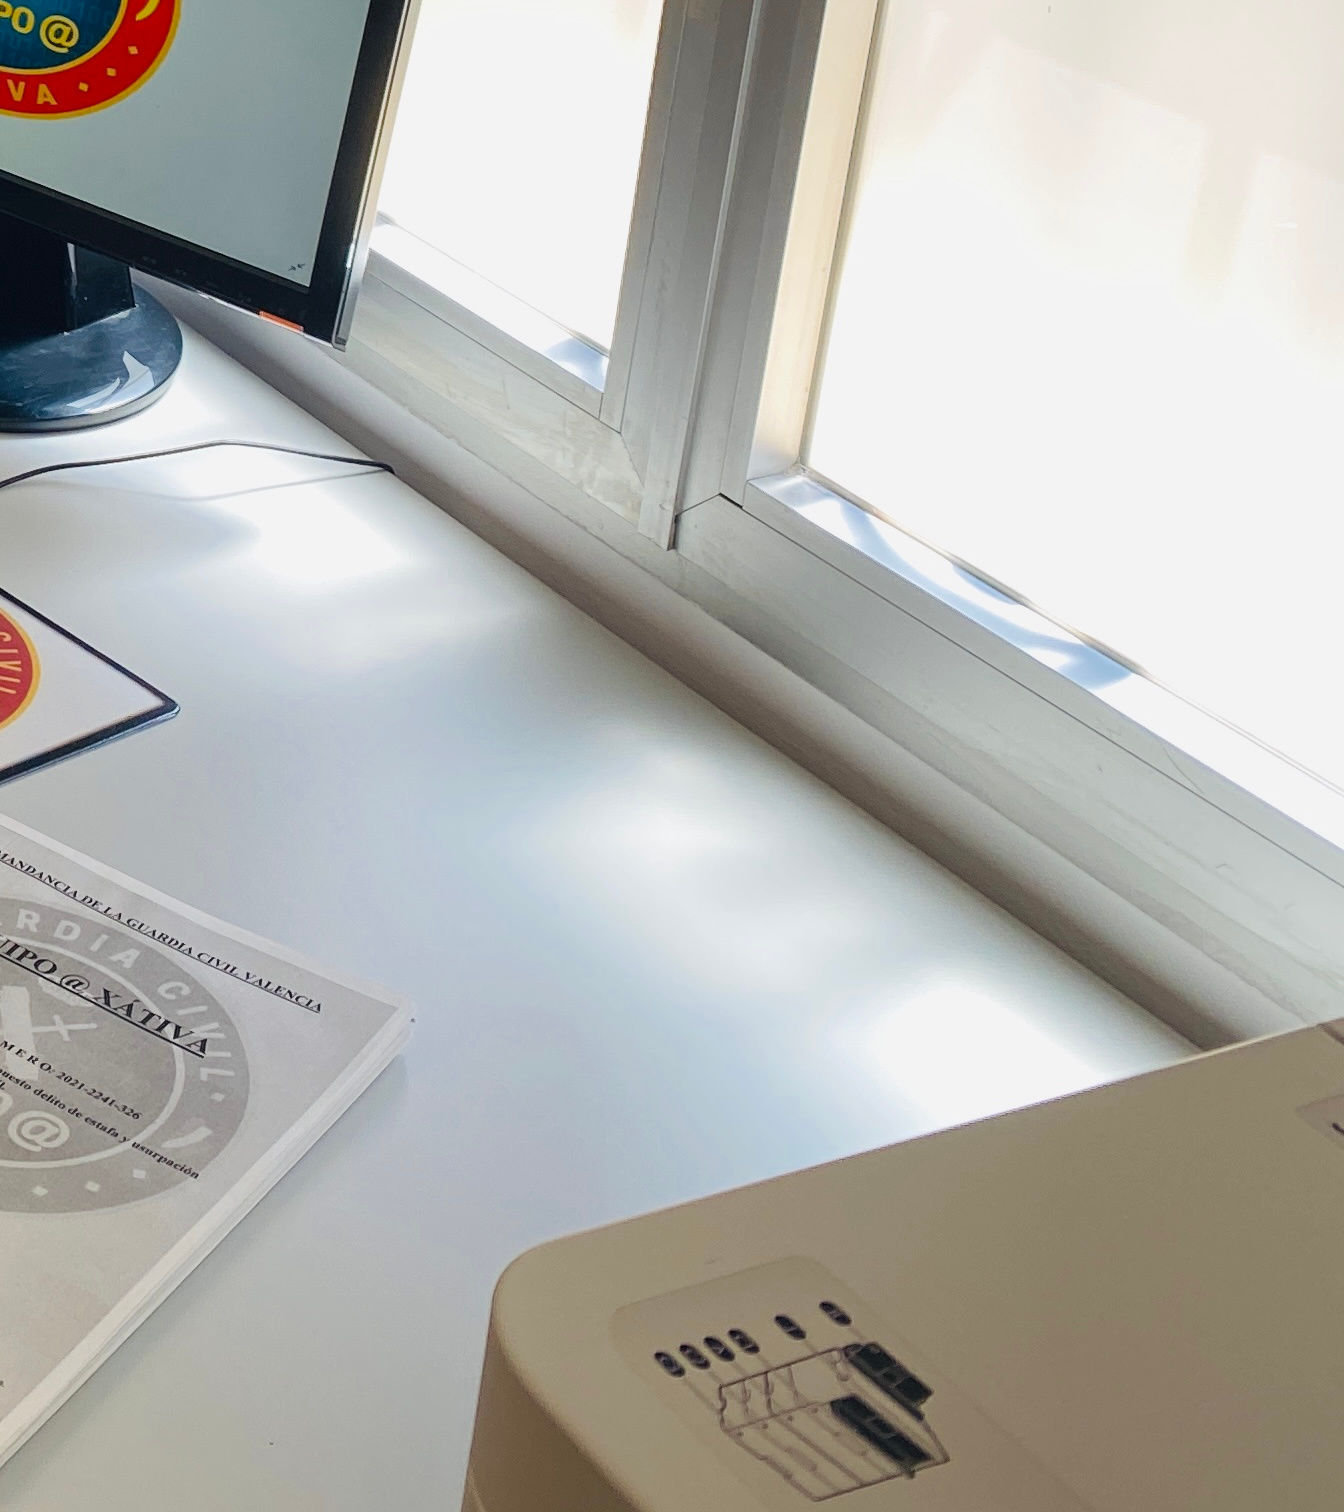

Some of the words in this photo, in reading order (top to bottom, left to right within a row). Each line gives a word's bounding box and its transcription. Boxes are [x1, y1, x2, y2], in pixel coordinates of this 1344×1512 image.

[39, 14, 80, 53] @
[80, 895, 101, 910] DE
[103, 906, 122, 920] LA
[126, 918, 192, 956] GUARDIA
[196, 952, 237, 977] CIVIL
[245, 971, 321, 1012] VALENCIA
[54, 974, 90, 996] @
[92, 987, 207, 1058] XÁTIVA
[157, 981, 235, 1080] CIVIL
[7, 1110, 70, 1152] @
[33, 1089, 65, 1109] delito
[67, 1107, 82, 1118] de
[84, 1117, 118, 1137] estafa
[131, 1141, 199, 1179] usurpación
[55, 1071, 141, 1119] 2021-2241-326
